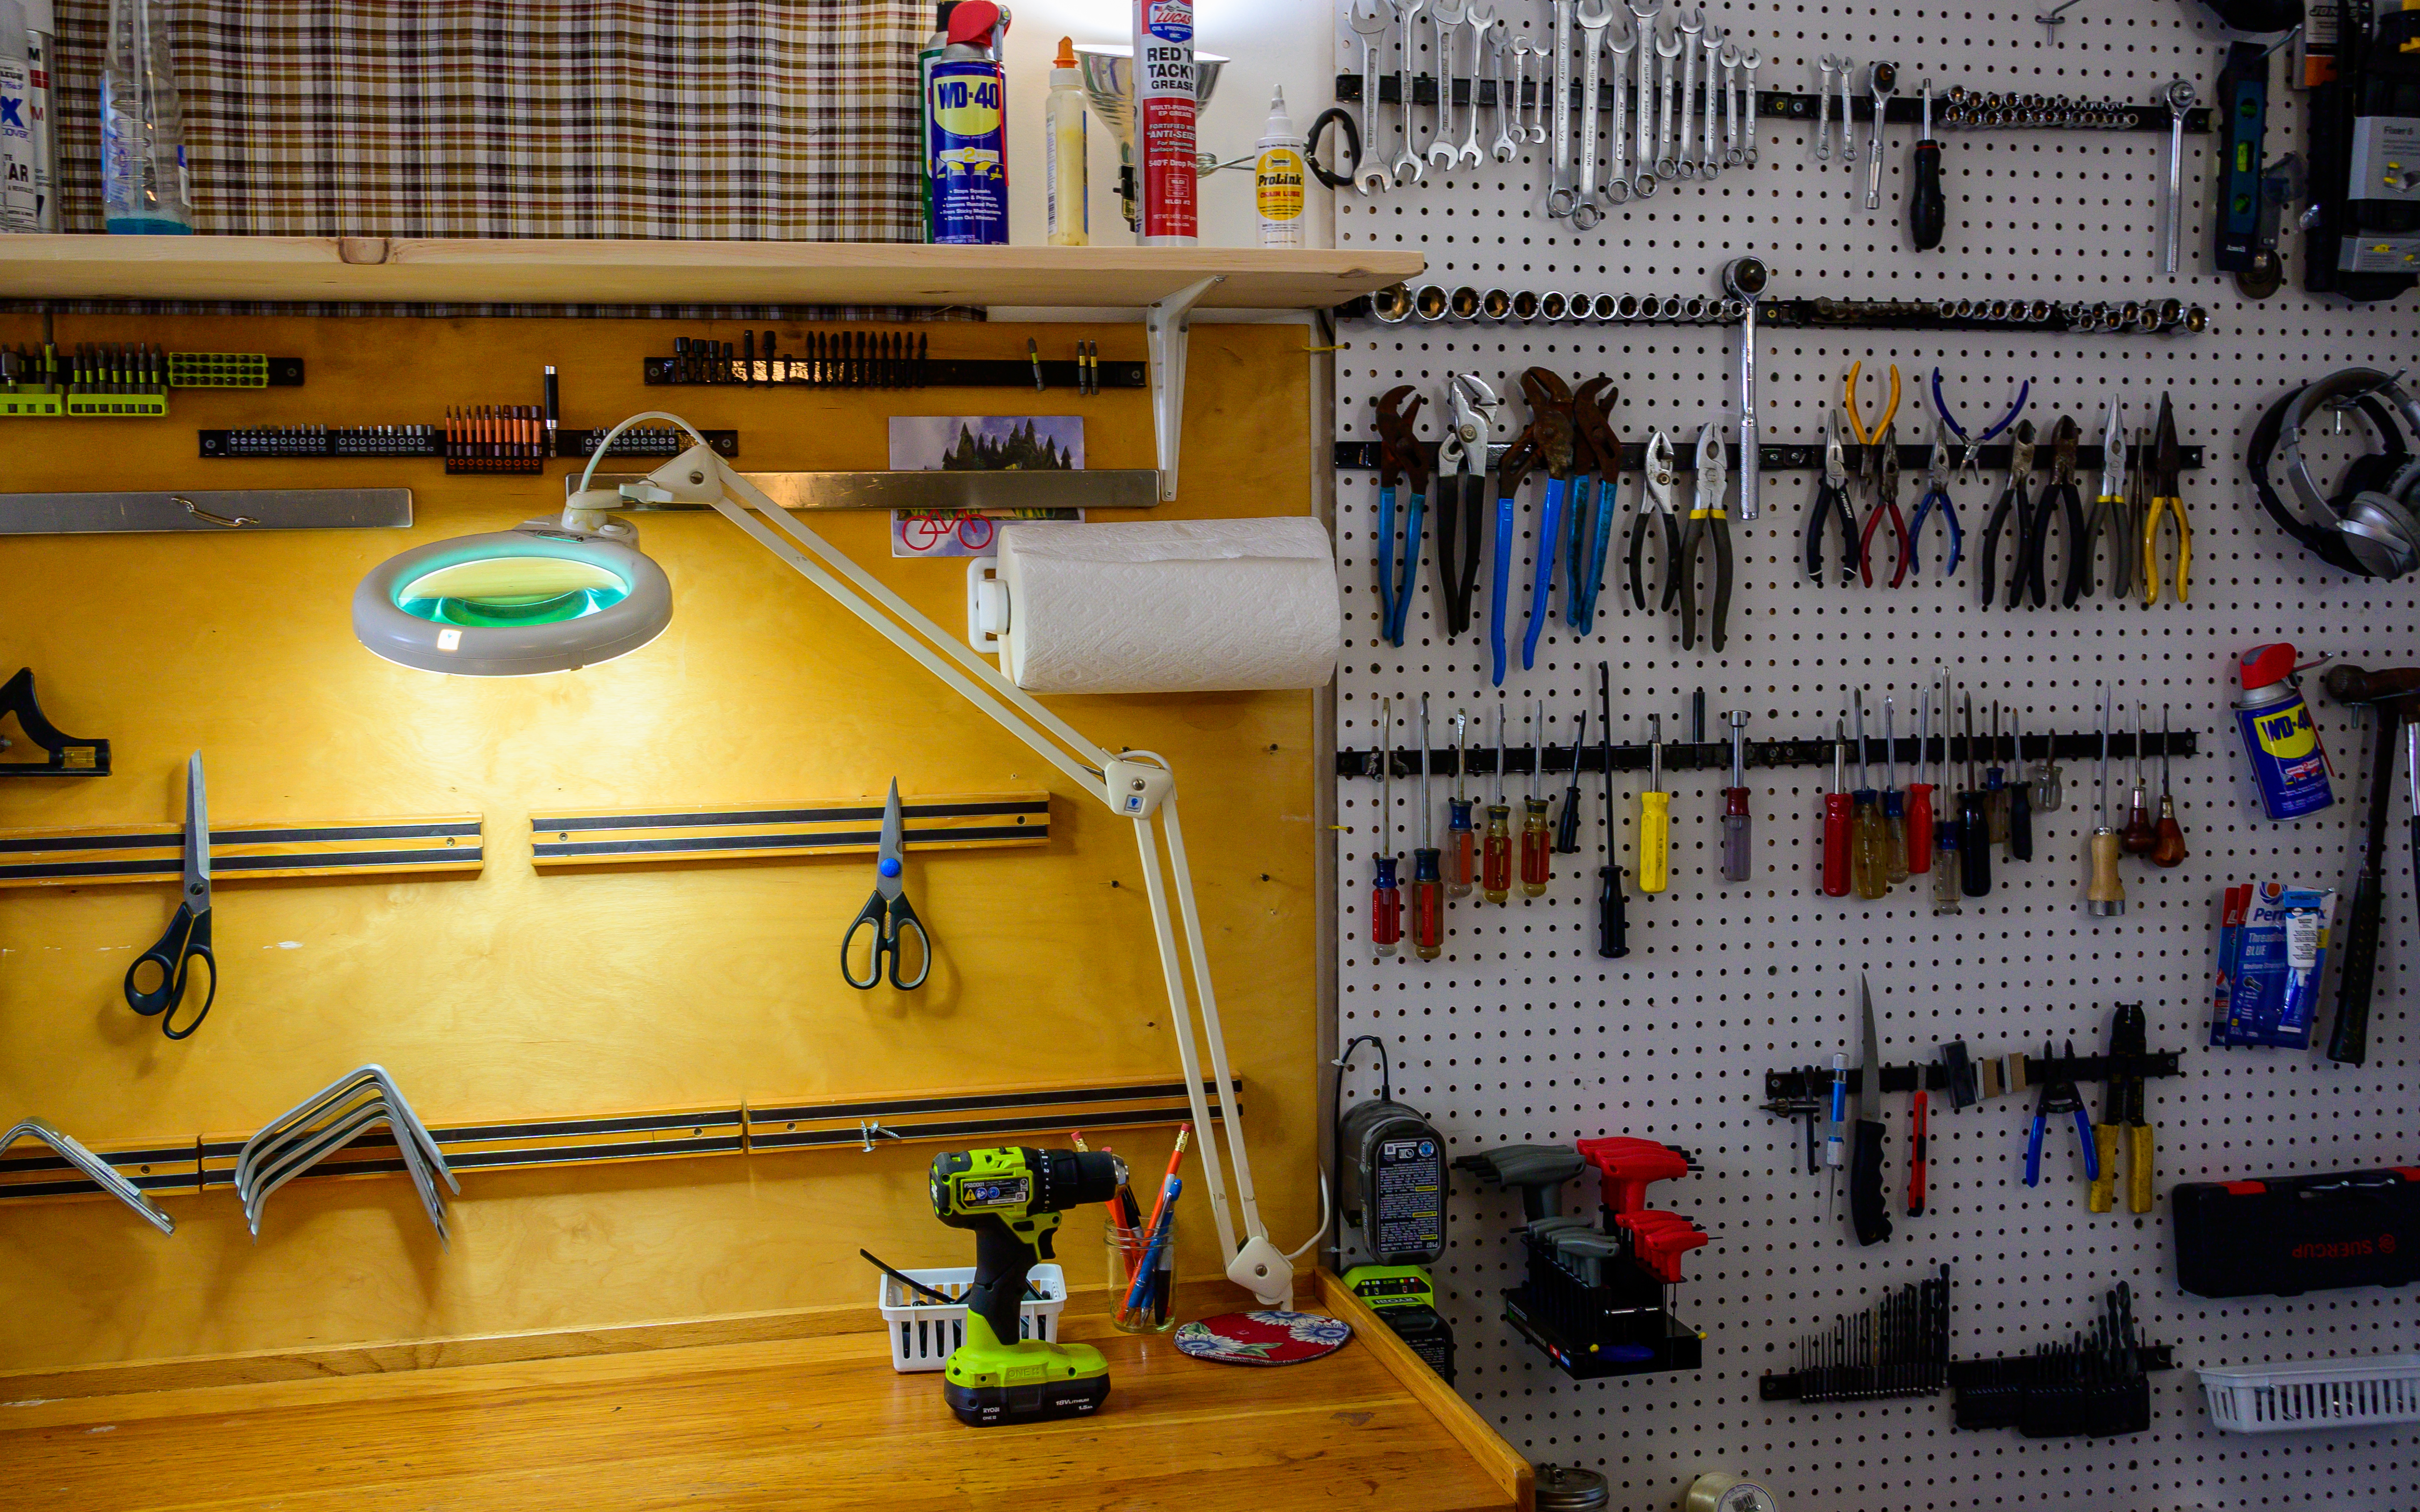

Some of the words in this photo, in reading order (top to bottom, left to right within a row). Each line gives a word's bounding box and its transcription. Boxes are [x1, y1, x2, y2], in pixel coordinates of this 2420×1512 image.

[1154, 12, 1192, 24] LUCAS
[1147, 47, 1181, 62] RED
[1147, 63, 1193, 80] TACKY
[1151, 80, 1193, 92] GREASE
[937, 81, 1000, 110] WD-40
[964, 147, 976, 162] 2
[1170, 159, 1187, 169] Drop
[1258, 173, 1302, 186] ProLink
[2245, 945, 2267, 956] BLUE
[2291, 1240, 2373, 1258] SUERCUP
